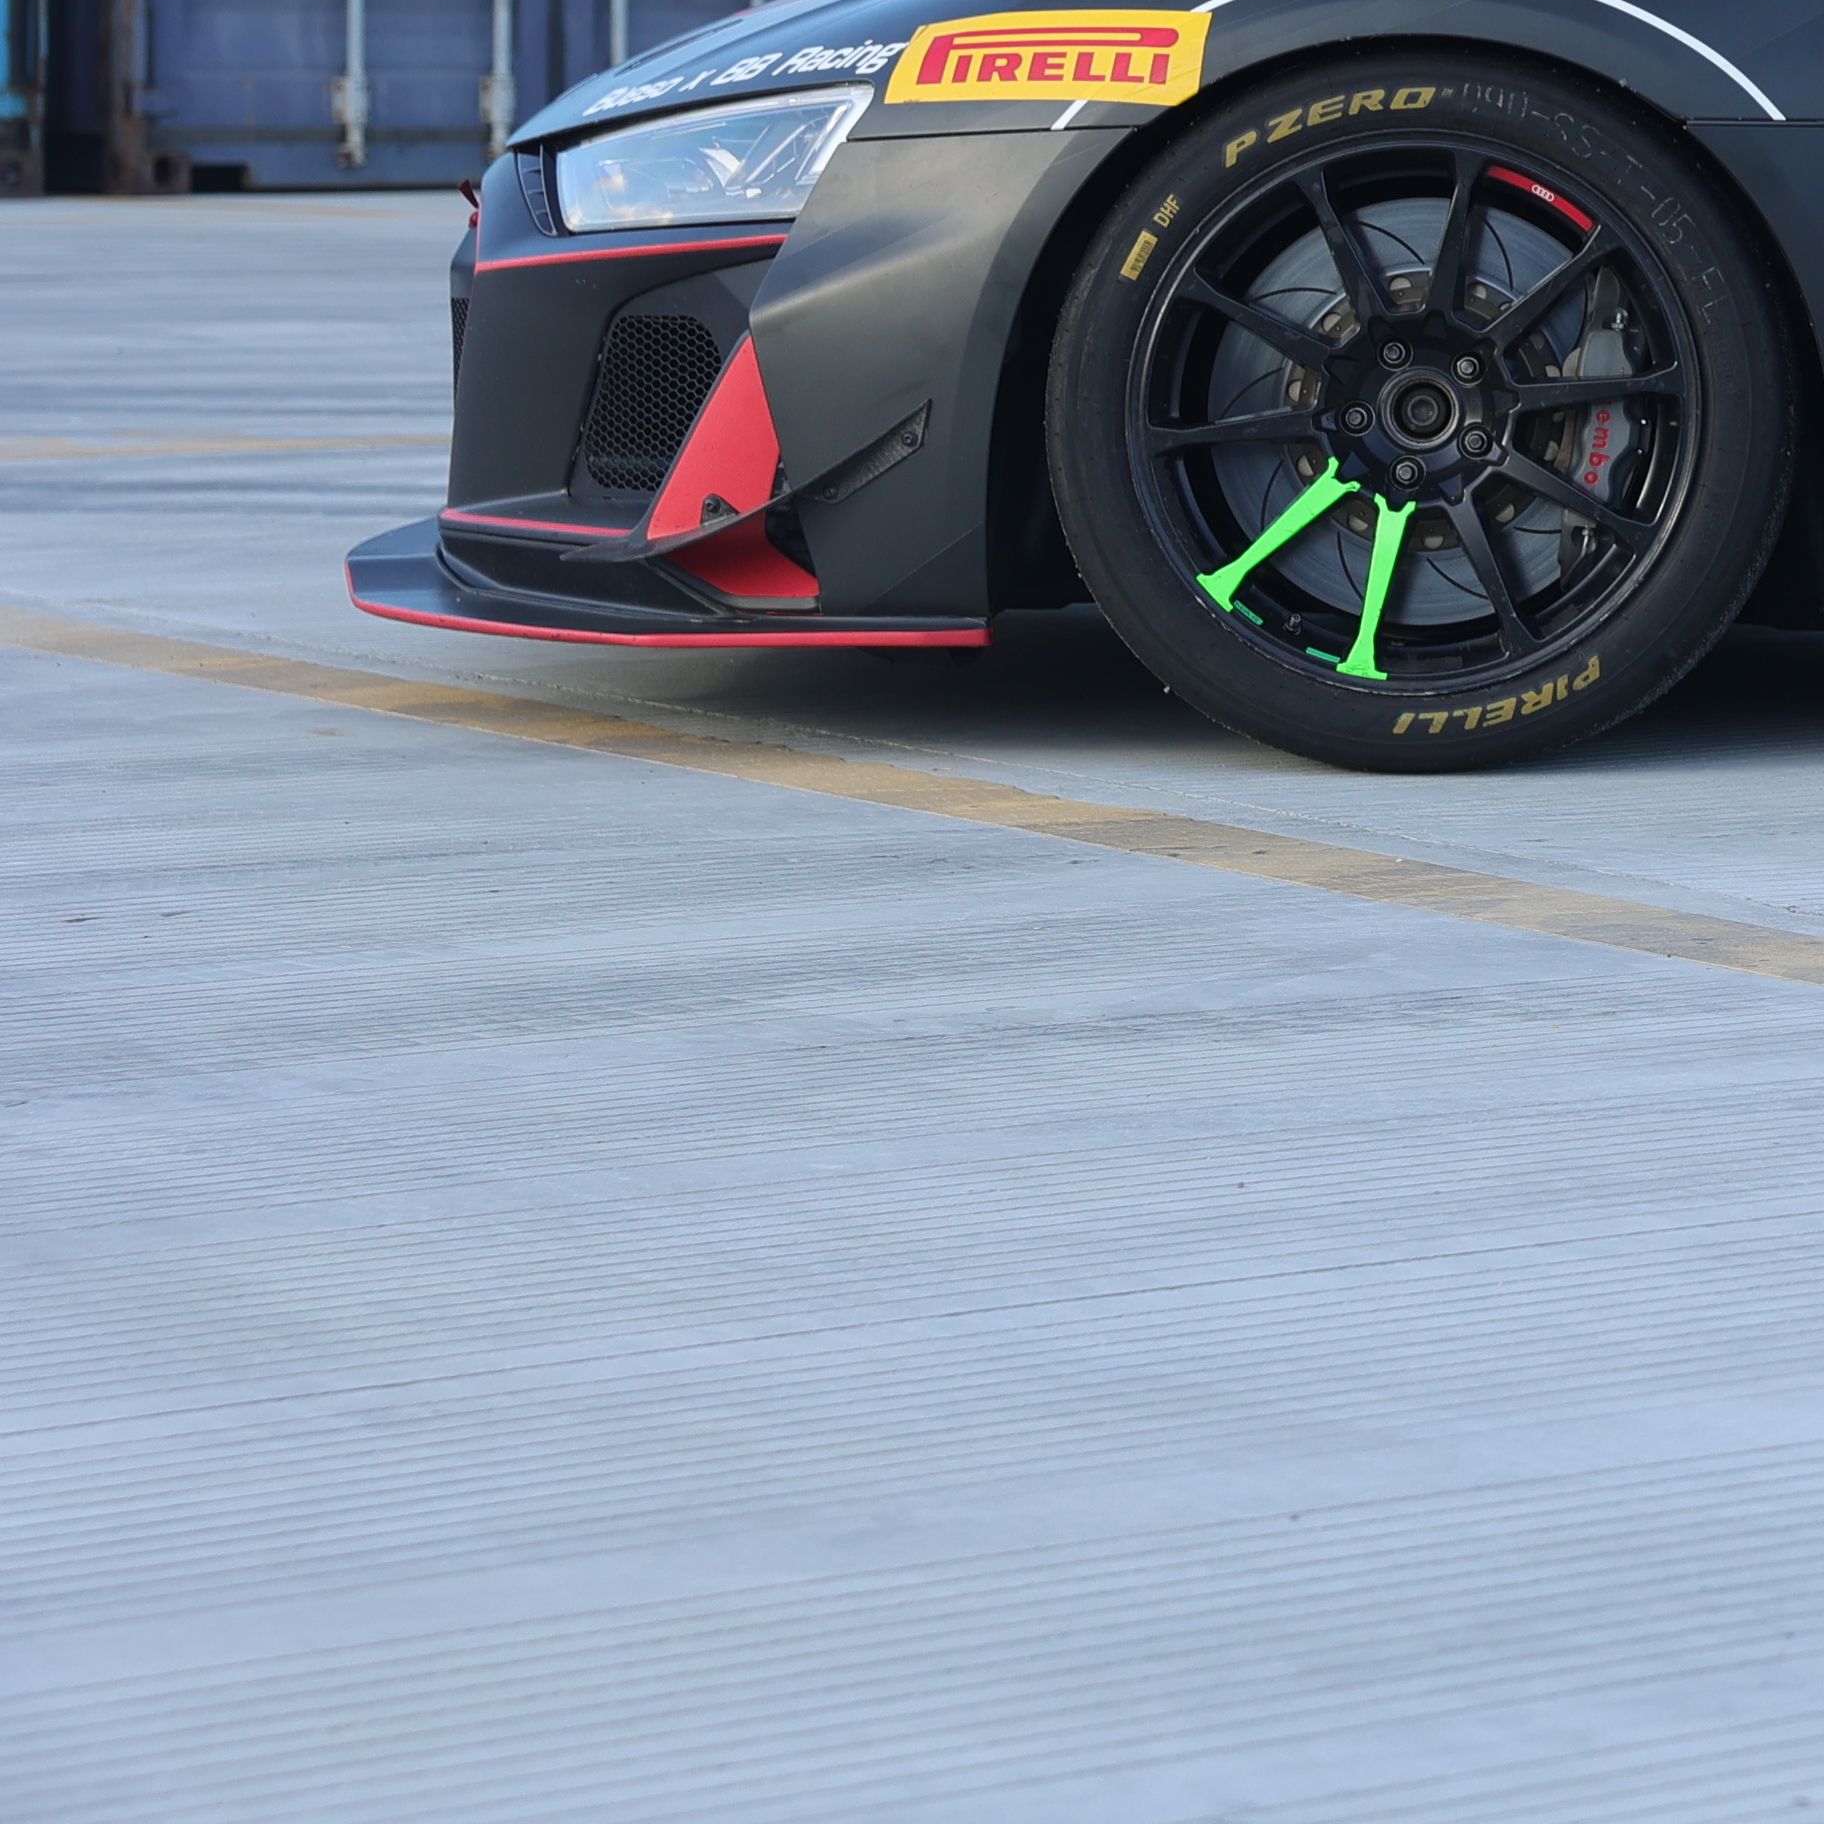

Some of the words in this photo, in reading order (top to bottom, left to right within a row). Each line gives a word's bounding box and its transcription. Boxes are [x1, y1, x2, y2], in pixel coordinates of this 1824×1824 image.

[711, 52, 783, 86] BB
[772, 39, 908, 76] Racing
[915, 27, 1179, 85] PIRELLI
[1153, 193, 1181, 227] DHF
[1392, 655, 1601, 735] PIRELLI
